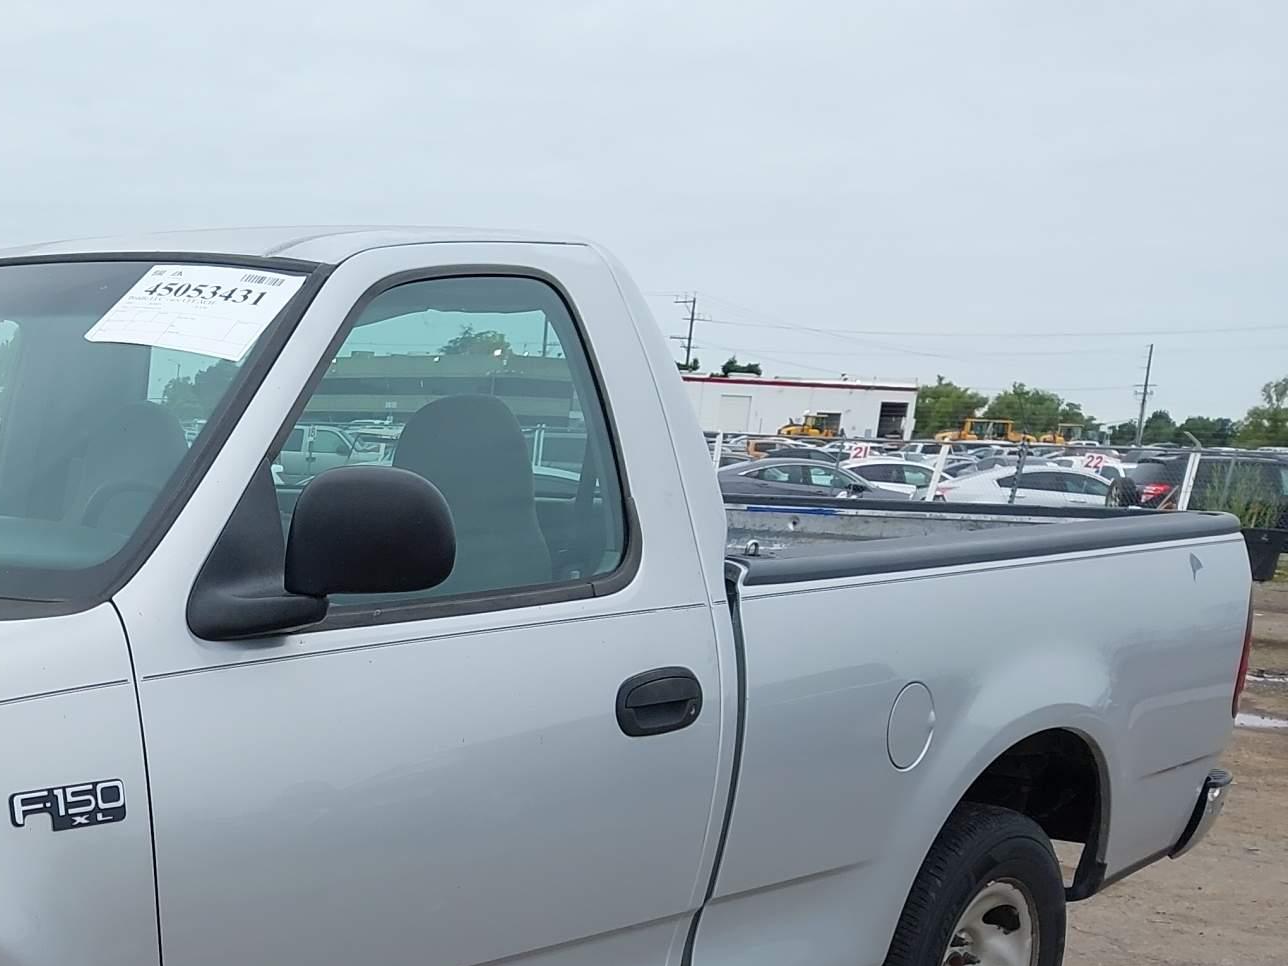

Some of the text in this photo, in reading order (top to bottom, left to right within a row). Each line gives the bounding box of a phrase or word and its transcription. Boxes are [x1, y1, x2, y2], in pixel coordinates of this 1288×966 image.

[144, 281, 268, 306] 45053431
[852, 445, 870, 460] 21
[1086, 454, 1104, 470] 22
